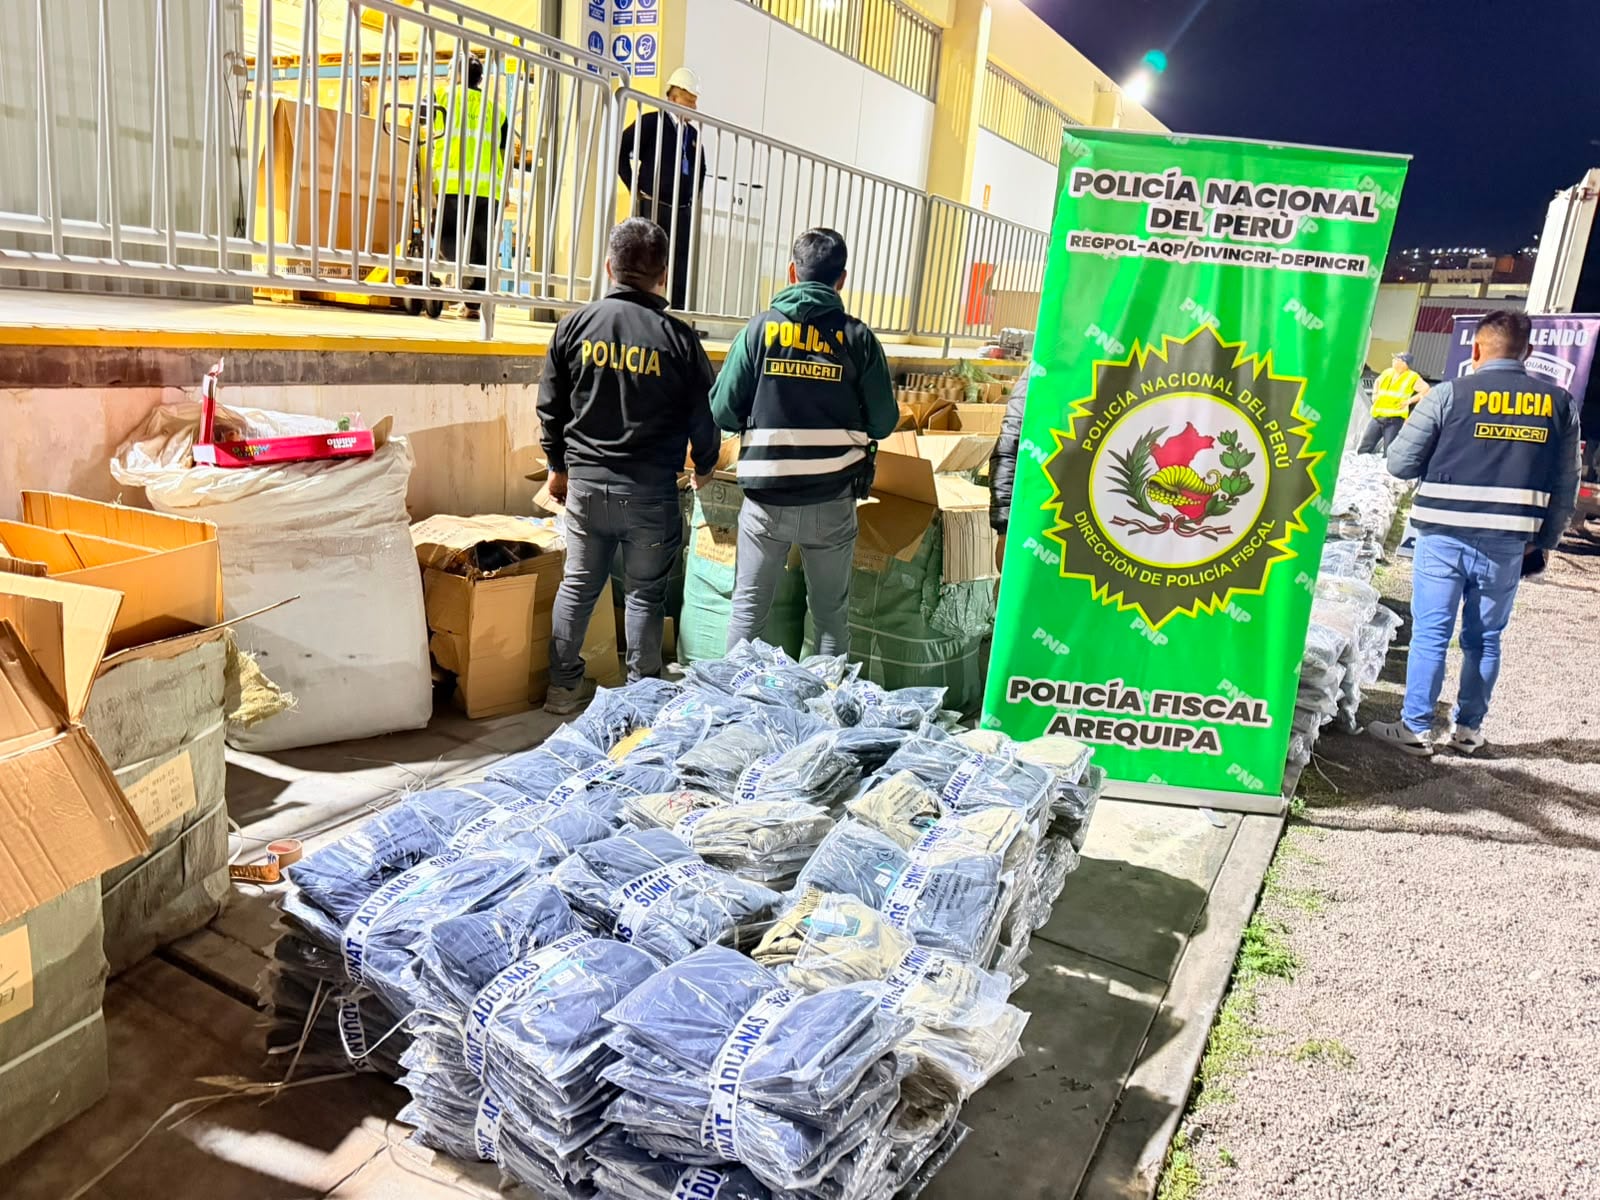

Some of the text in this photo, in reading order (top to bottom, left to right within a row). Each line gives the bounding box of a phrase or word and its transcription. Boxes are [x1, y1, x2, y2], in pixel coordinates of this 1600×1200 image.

[1073, 171, 1375, 218] POLICÍA NACIONAL
[1150, 207, 1204, 233] DEL
[1070, 234, 1365, 272] REGPOL-AQP/DIVINCRI-DEPINCRI
[1283, 298, 1324, 330] PNP
[1084, 323, 1126, 355] PNP
[1529, 328, 1590, 347] LENDO
[581, 339, 662, 377] POLICIA
[770, 360, 838, 379] DIVINCRI
[1525, 361, 1560, 377] DUANAS
[1297, 399, 1322, 422] NP
[1473, 390, 1553, 418] POLICIA
[1081, 371, 1293, 470] POLICÍA NACIONAL DEL PERÚ
[1478, 425, 1546, 441] DIVINCRI
[1019, 438, 1048, 465] PN
[1022, 536, 1060, 566] PNP
[1074, 510, 1276, 587] DIRECCIÓN DE POLICÍA FISCAL
[1224, 601, 1252, 623] NP
[1031, 626, 1071, 656] PNP
[1009, 679, 1268, 723] POLICÍA FISCAL
[1047, 715, 1218, 751] AREQUIPA
[1225, 762, 1264, 791] PNP
[358, 872, 421, 929] ADUANAS
[634, 873, 679, 908] SUNAT
[466, 1033, 485, 1077] UNAT
[718, 1014, 770, 1096] ADUANAS
[715, 1113, 740, 1162] UNAT
